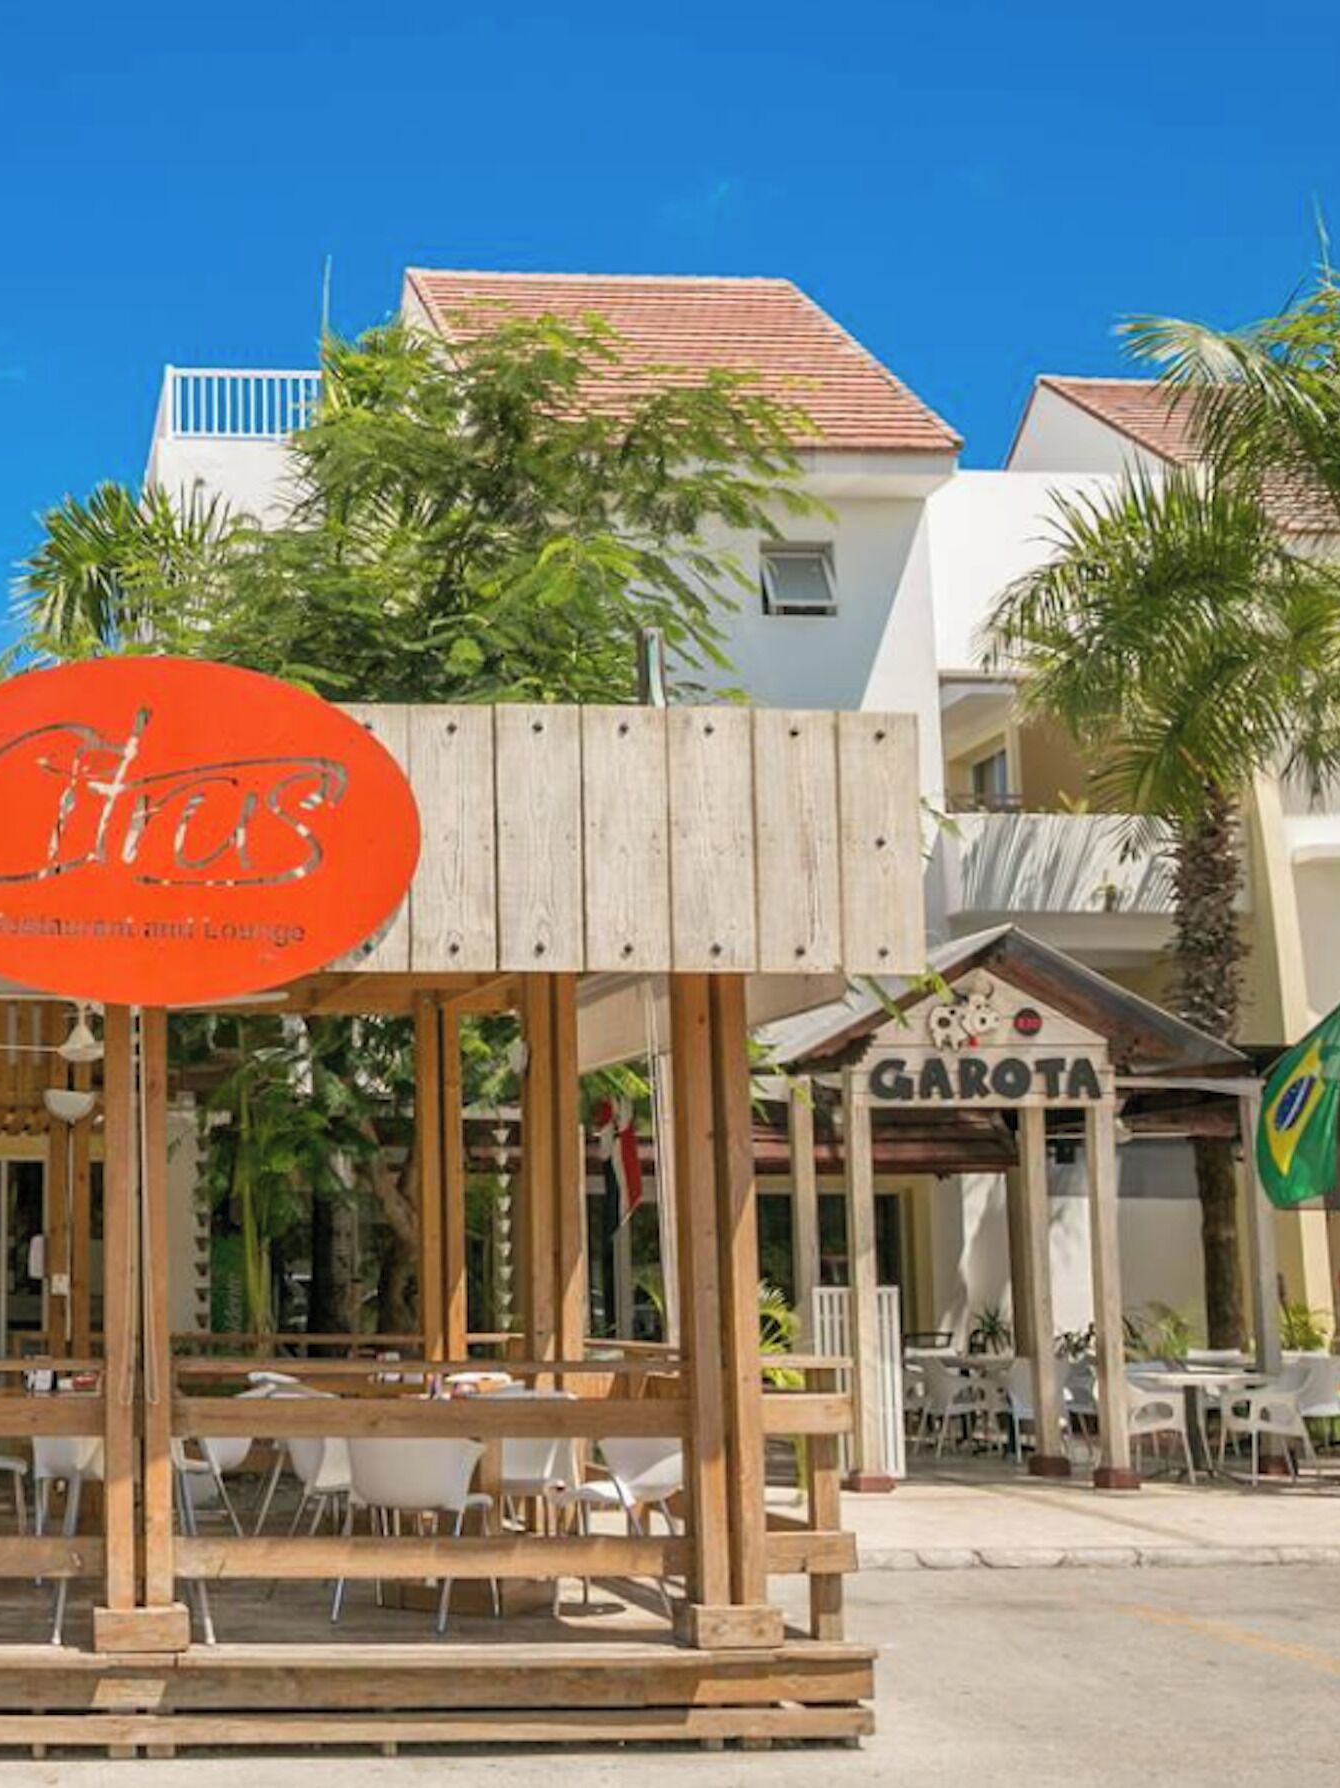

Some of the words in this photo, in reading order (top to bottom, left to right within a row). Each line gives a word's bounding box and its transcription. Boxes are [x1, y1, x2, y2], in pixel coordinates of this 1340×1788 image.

[144, 916, 193, 939] and
[203, 916, 306, 948] Lounge
[868, 1057, 1102, 1101] GAROTA
